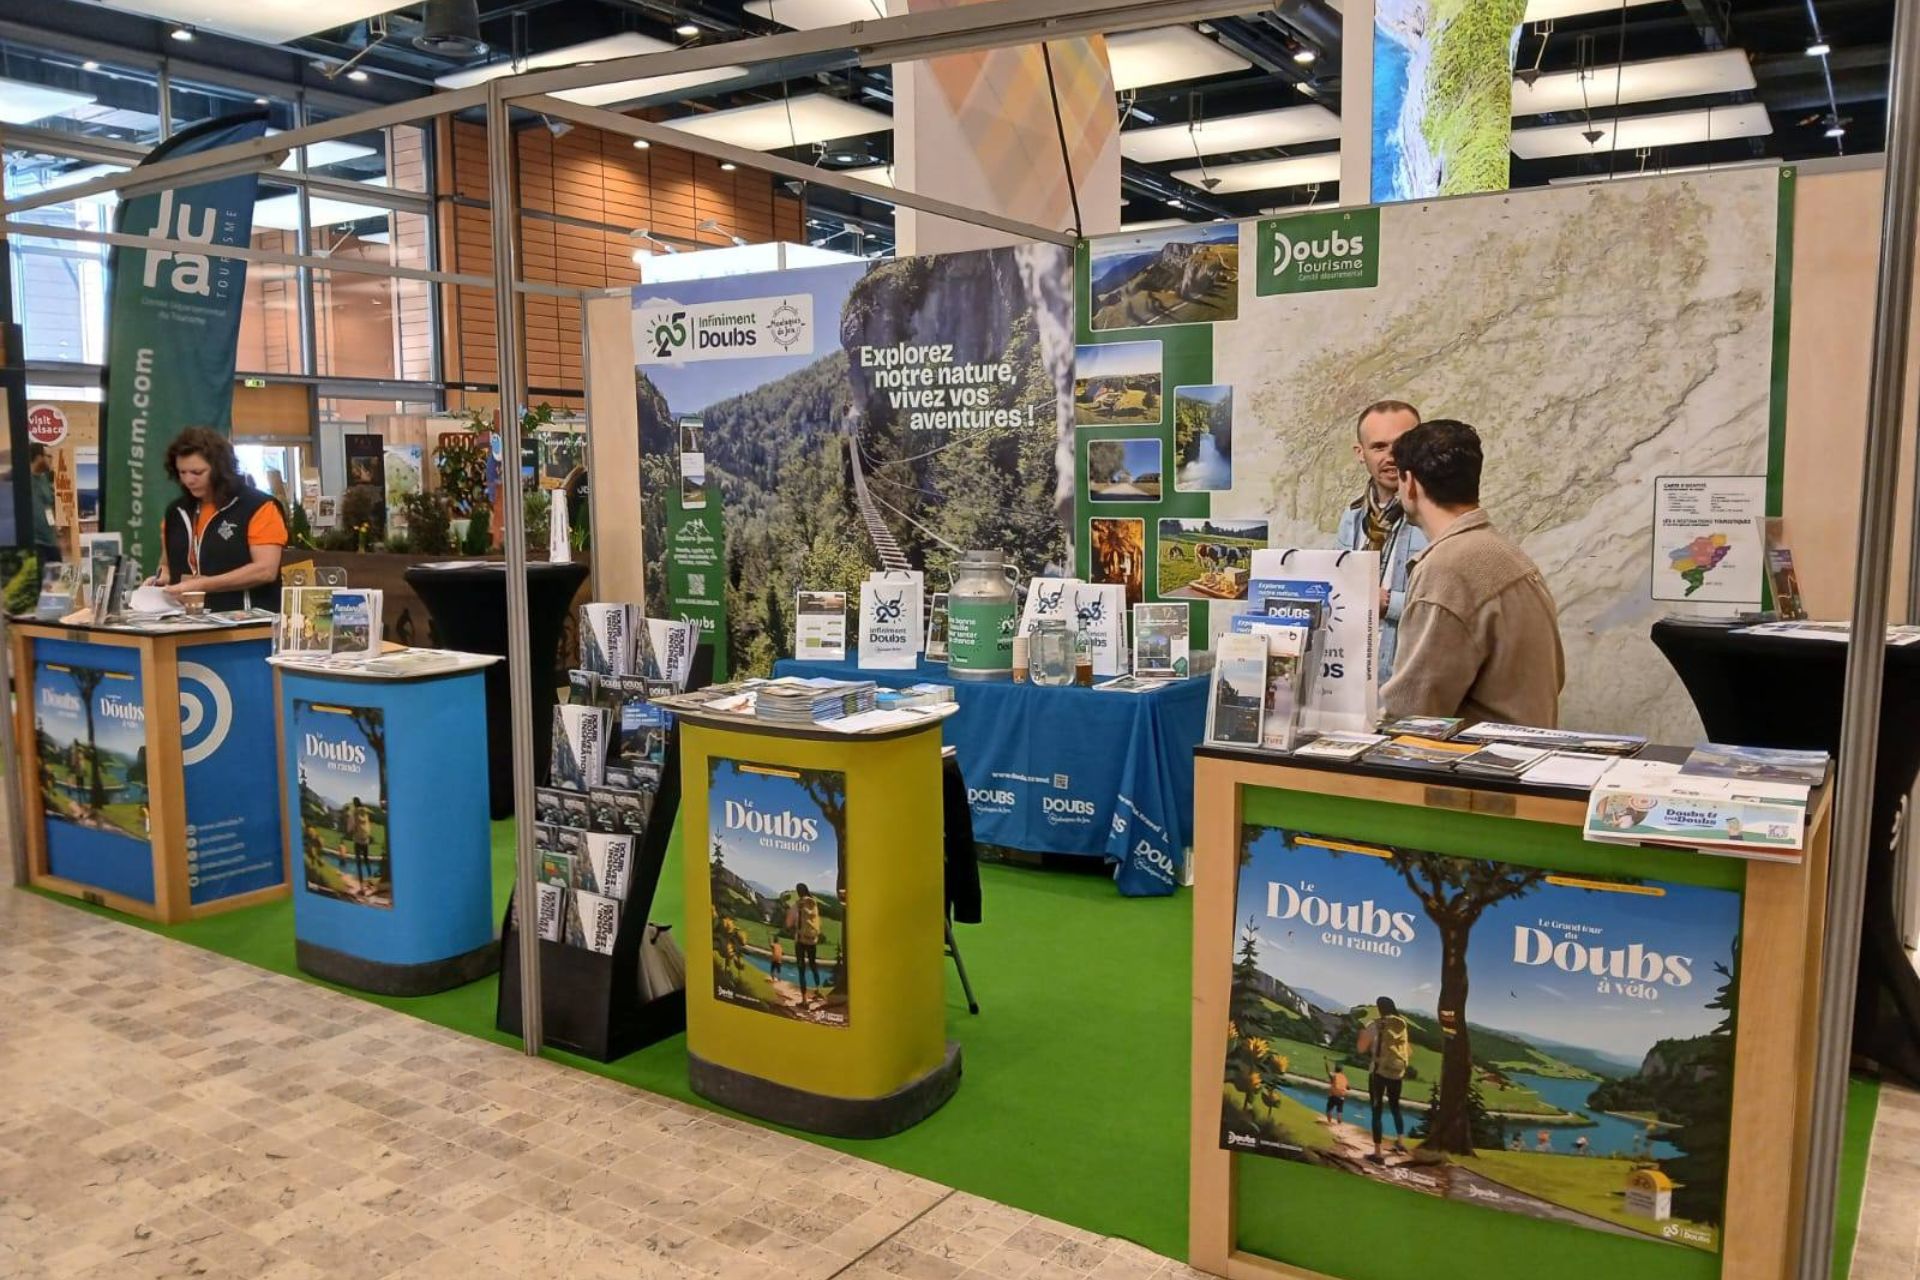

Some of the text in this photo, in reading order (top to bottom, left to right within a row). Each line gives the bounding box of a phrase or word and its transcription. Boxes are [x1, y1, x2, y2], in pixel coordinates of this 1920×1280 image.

[1273, 229, 1364, 276] Doubs
[1297, 259, 1363, 273] Tourisme
[699, 313, 757, 328] Infiniment
[700, 328, 757, 349] Doubs
[861, 342, 953, 369] Explorez
[875, 362, 1018, 388] notre nature,
[889, 387, 990, 408] vivez vos
[910, 404, 1035, 431] aventures !
[870, 633, 906, 644] Doubs
[101, 697, 145, 721] Doubs
[306, 733, 366, 764] Doubs
[967, 788, 1015, 805] DOUBS
[1043, 797, 1095, 815] DOUBS
[724, 800, 818, 842] Doubs
[1666, 809, 1704, 817] Doubs
[774, 839, 810, 853] rando
[1300, 880, 1315, 892] Le
[1266, 881, 1416, 943] Doubs
[1321, 931, 1402, 958] en rando
[1565, 930, 1578, 940] du
[1513, 925, 1693, 987] Doubs
[1597, 976, 1658, 1001] à vélo
